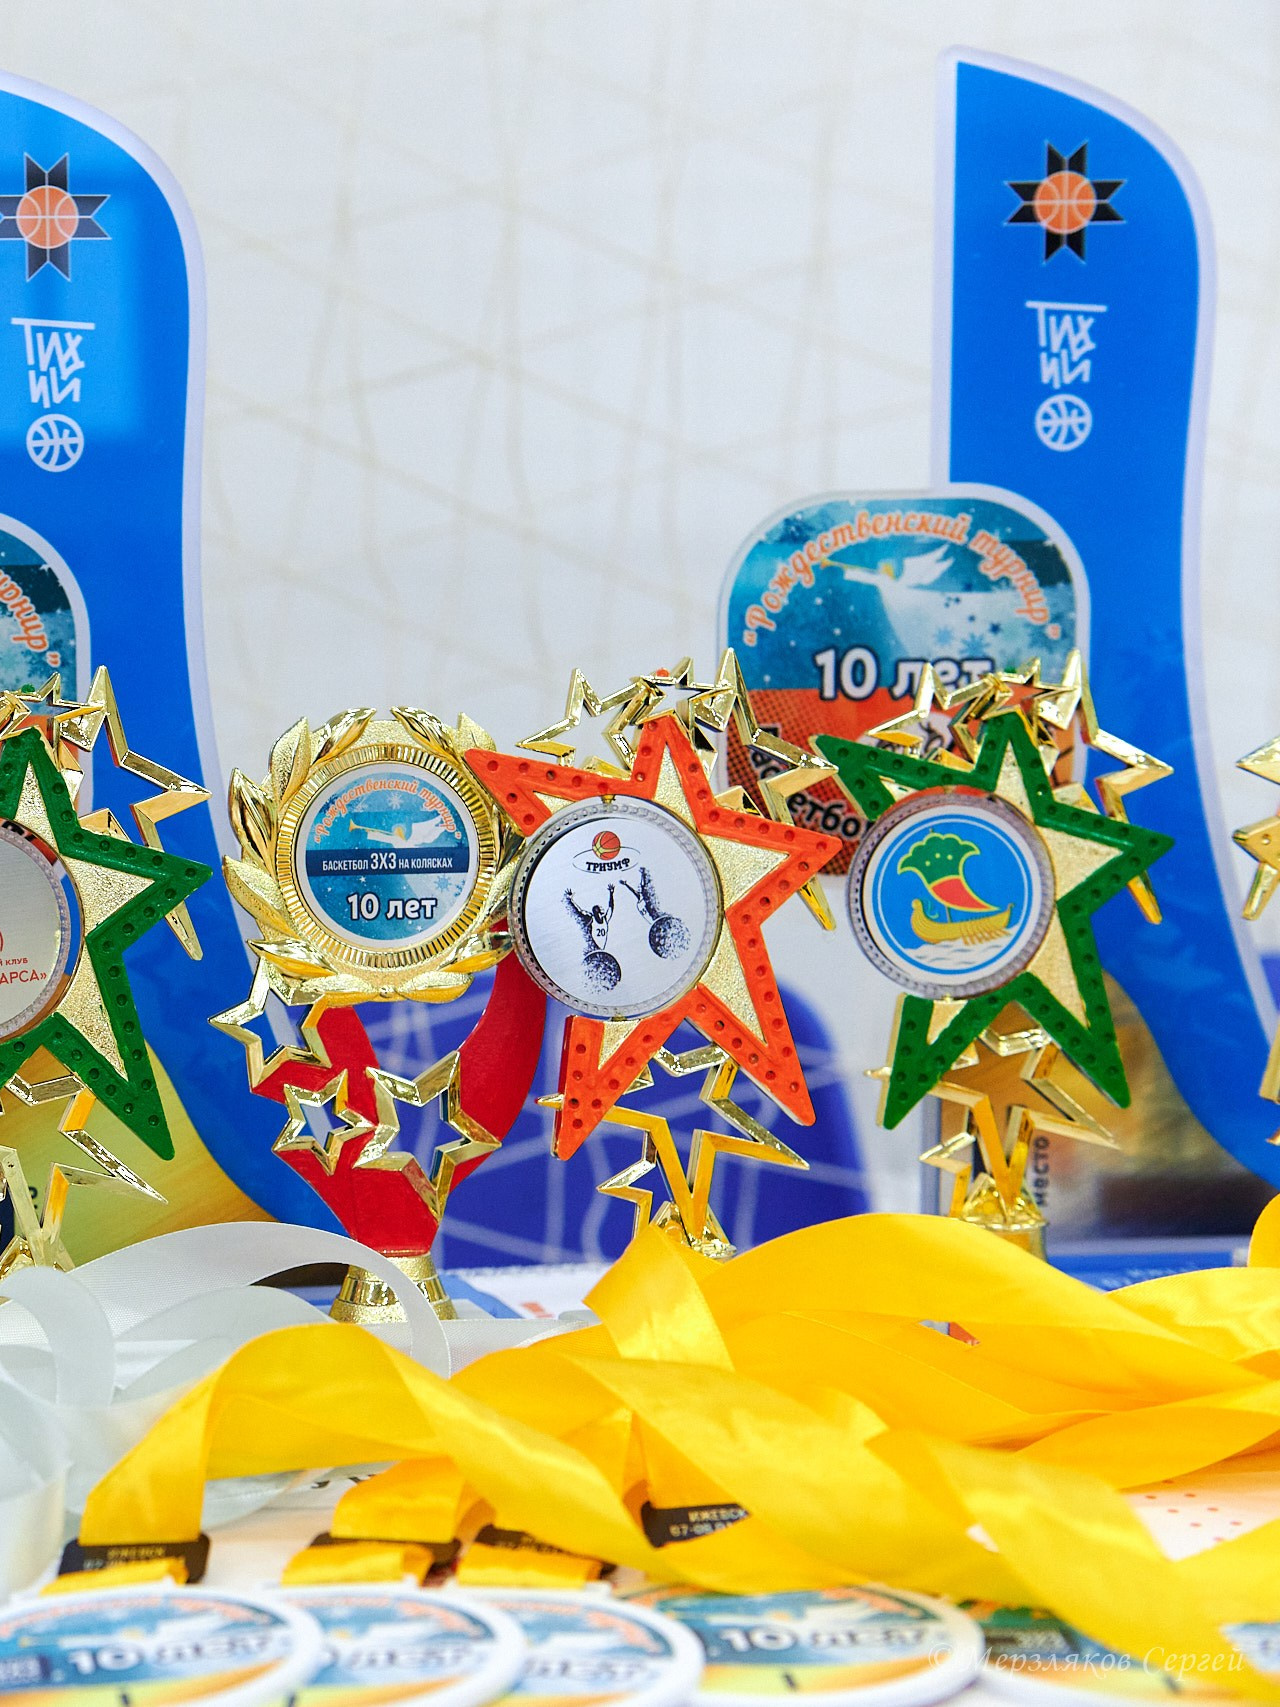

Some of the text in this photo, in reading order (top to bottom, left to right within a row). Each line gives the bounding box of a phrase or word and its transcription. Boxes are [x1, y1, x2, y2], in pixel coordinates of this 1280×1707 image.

[813, 646, 880, 701] 10
[322, 860, 369, 871] БАСКЕТБОЛ
[398, 859, 410, 869] НА
[411, 857, 453, 869] КОЛЯСКАХ
[348, 893, 437, 921] 10 лет
[596, 928, 606, 937] 20
[5, 957, 29, 966] КЛУБ
